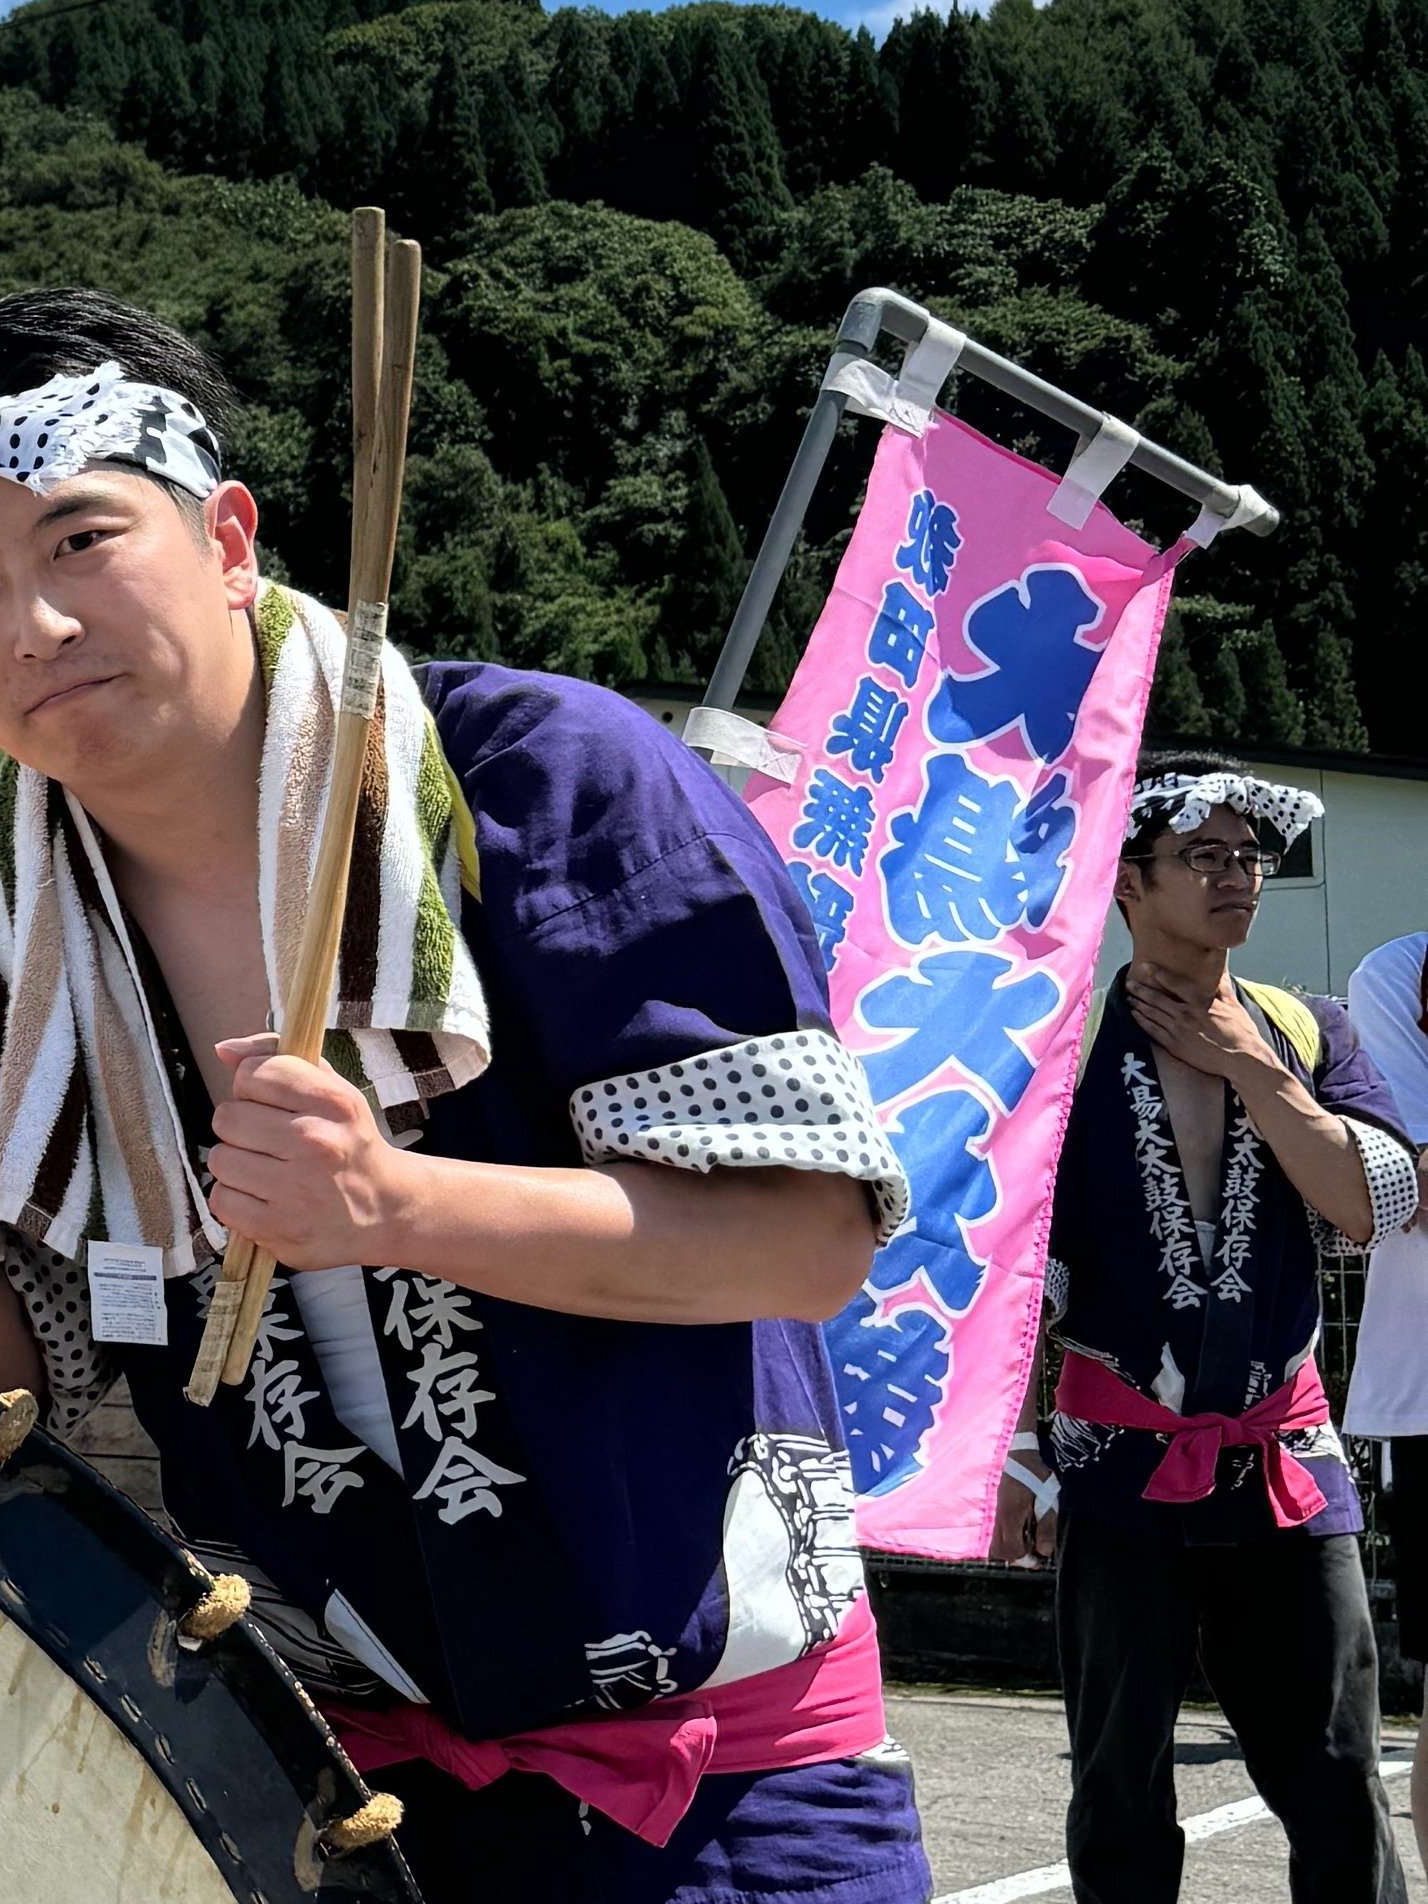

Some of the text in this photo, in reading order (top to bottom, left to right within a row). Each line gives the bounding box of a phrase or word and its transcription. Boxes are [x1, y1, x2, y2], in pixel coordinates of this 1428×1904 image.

[1210, 1095, 1266, 1303] 大太鼓保存会
[372, 1266, 527, 1525] 保存会
